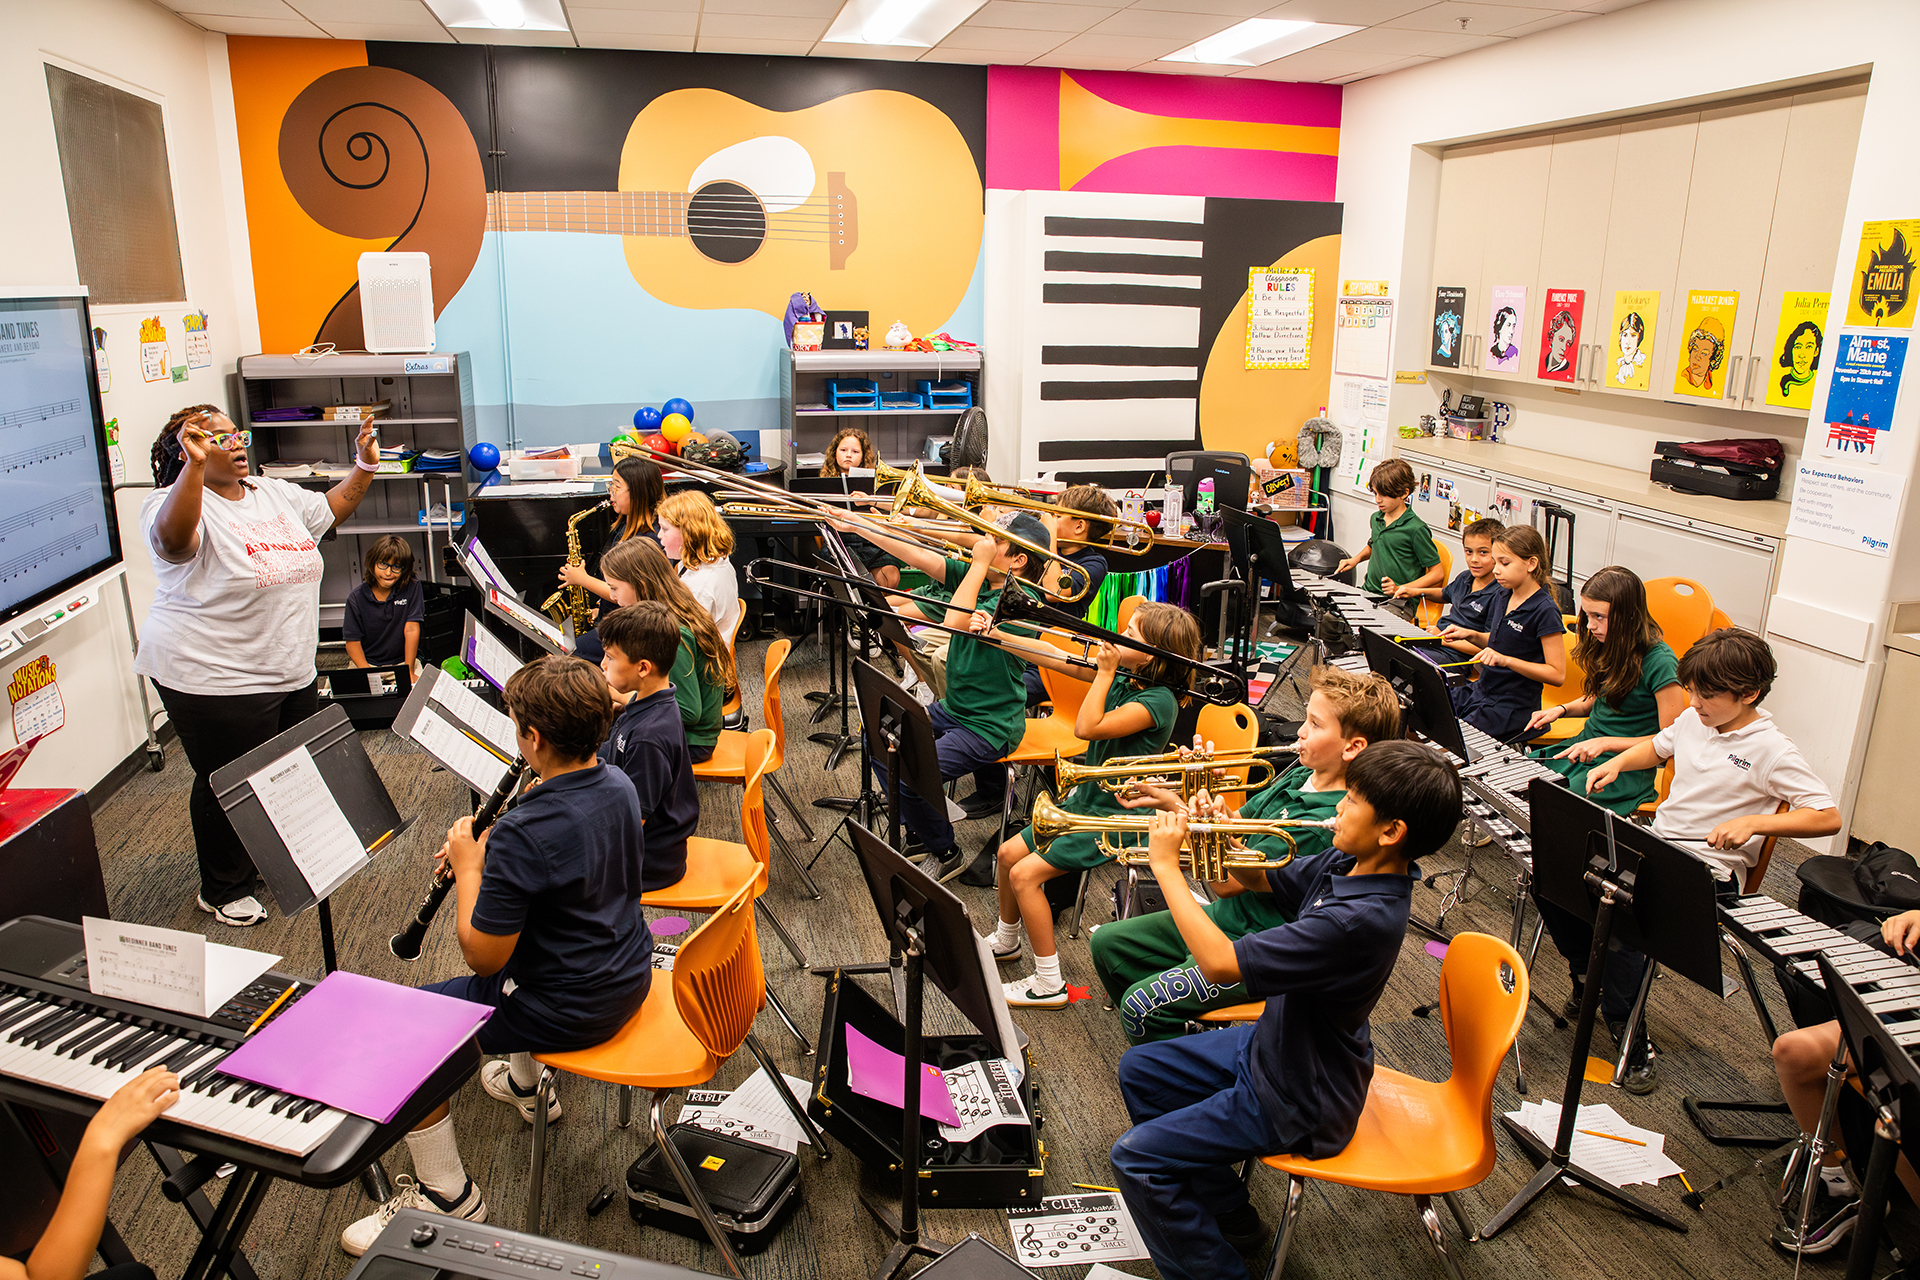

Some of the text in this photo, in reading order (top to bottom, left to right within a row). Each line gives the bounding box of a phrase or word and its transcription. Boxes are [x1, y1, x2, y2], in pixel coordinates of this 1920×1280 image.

[1265, 274, 1299, 283] Classroom
[1867, 272, 1904, 291] EMILIA
[1267, 282, 1296, 292] RULES
[1349, 281, 1380, 295] SEPTEMBER
[1261, 293, 1272, 301] Be
[1278, 293, 1296, 301] Kind
[1691, 294, 1735, 306] MARGARET BONDS
[1794, 296, 1830, 309] Julia Perr
[16, 321, 40, 339] TUNES
[183, 315, 204, 333] TEMPO
[1274, 331, 1304, 339] Directions
[1288, 346, 1305, 354] Hand
[1846, 347, 1888, 364] Maine
[405, 361, 429, 372] Extras
[1835, 366, 1860, 375] November
[1265, 474, 1291, 494] Oliver!
[1800, 467, 1864, 486] Our Expected Behaviors
[1801, 477, 1820, 487] Respect
[1830, 483, 1846, 493] others,
[1846, 486, 1856, 494] and
[1856, 488, 1865, 496] the
[1798, 496, 1807, 504] Act
[1806, 498, 1816, 506] with
[1796, 506, 1815, 515] Prioritize
[1795, 515, 1809, 524] Foster
[1808, 519, 1822, 528] safety
[1822, 522, 1832, 530] and
[1861, 535, 1889, 550] Pilgrim
[13, 659, 41, 686] MUSIC
[8, 663, 57, 704] NOTATIONS
[1727, 753, 1752, 769] Pilgrim
[125, 937, 148, 946] BEGINNER
[148, 941, 163, 950] BAND
[163, 943, 178, 953] TUNES
[1122, 964, 1241, 1038] ilgrim
[986, 1059, 1008, 1082] TREBLE
[997, 1082, 1017, 1101] CLEF
[749, 1131, 774, 1139] SPACES
[1051, 1197, 1083, 1210] CLEF
[1100, 1240, 1127, 1249] SPACES
